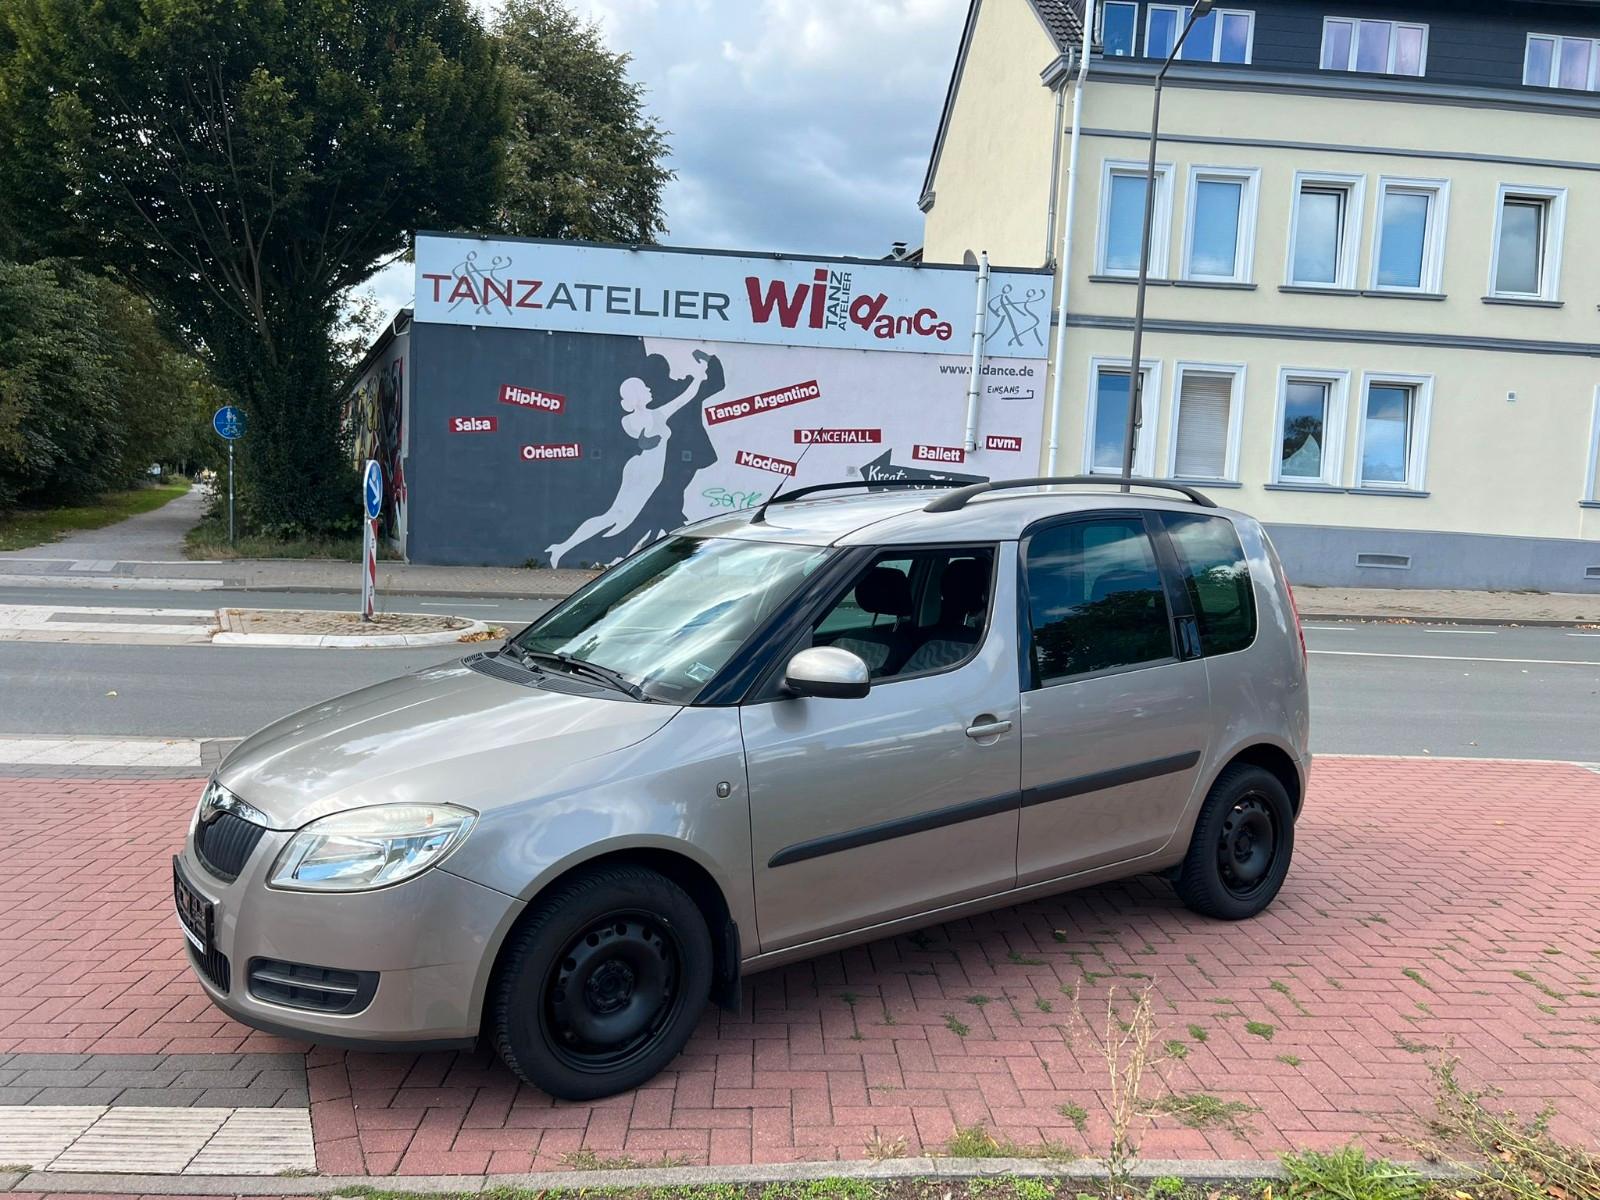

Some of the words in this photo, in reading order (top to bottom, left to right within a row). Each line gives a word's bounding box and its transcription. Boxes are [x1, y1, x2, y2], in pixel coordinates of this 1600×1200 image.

[825, 270, 844, 329] TANZ
[838, 272, 852, 331] ATELIER
[505, 387, 560, 410] HipHop
[708, 401, 750, 420] Tango
[754, 384, 818, 410] Argentino
[455, 417, 491, 432] Salsa
[801, 430, 873, 443] DANCEHALL
[988, 436, 1019, 449] uvm.
[523, 444, 579, 459] Oriental
[918, 445, 961, 462] Ballett
[740, 452, 793, 475] Modern
